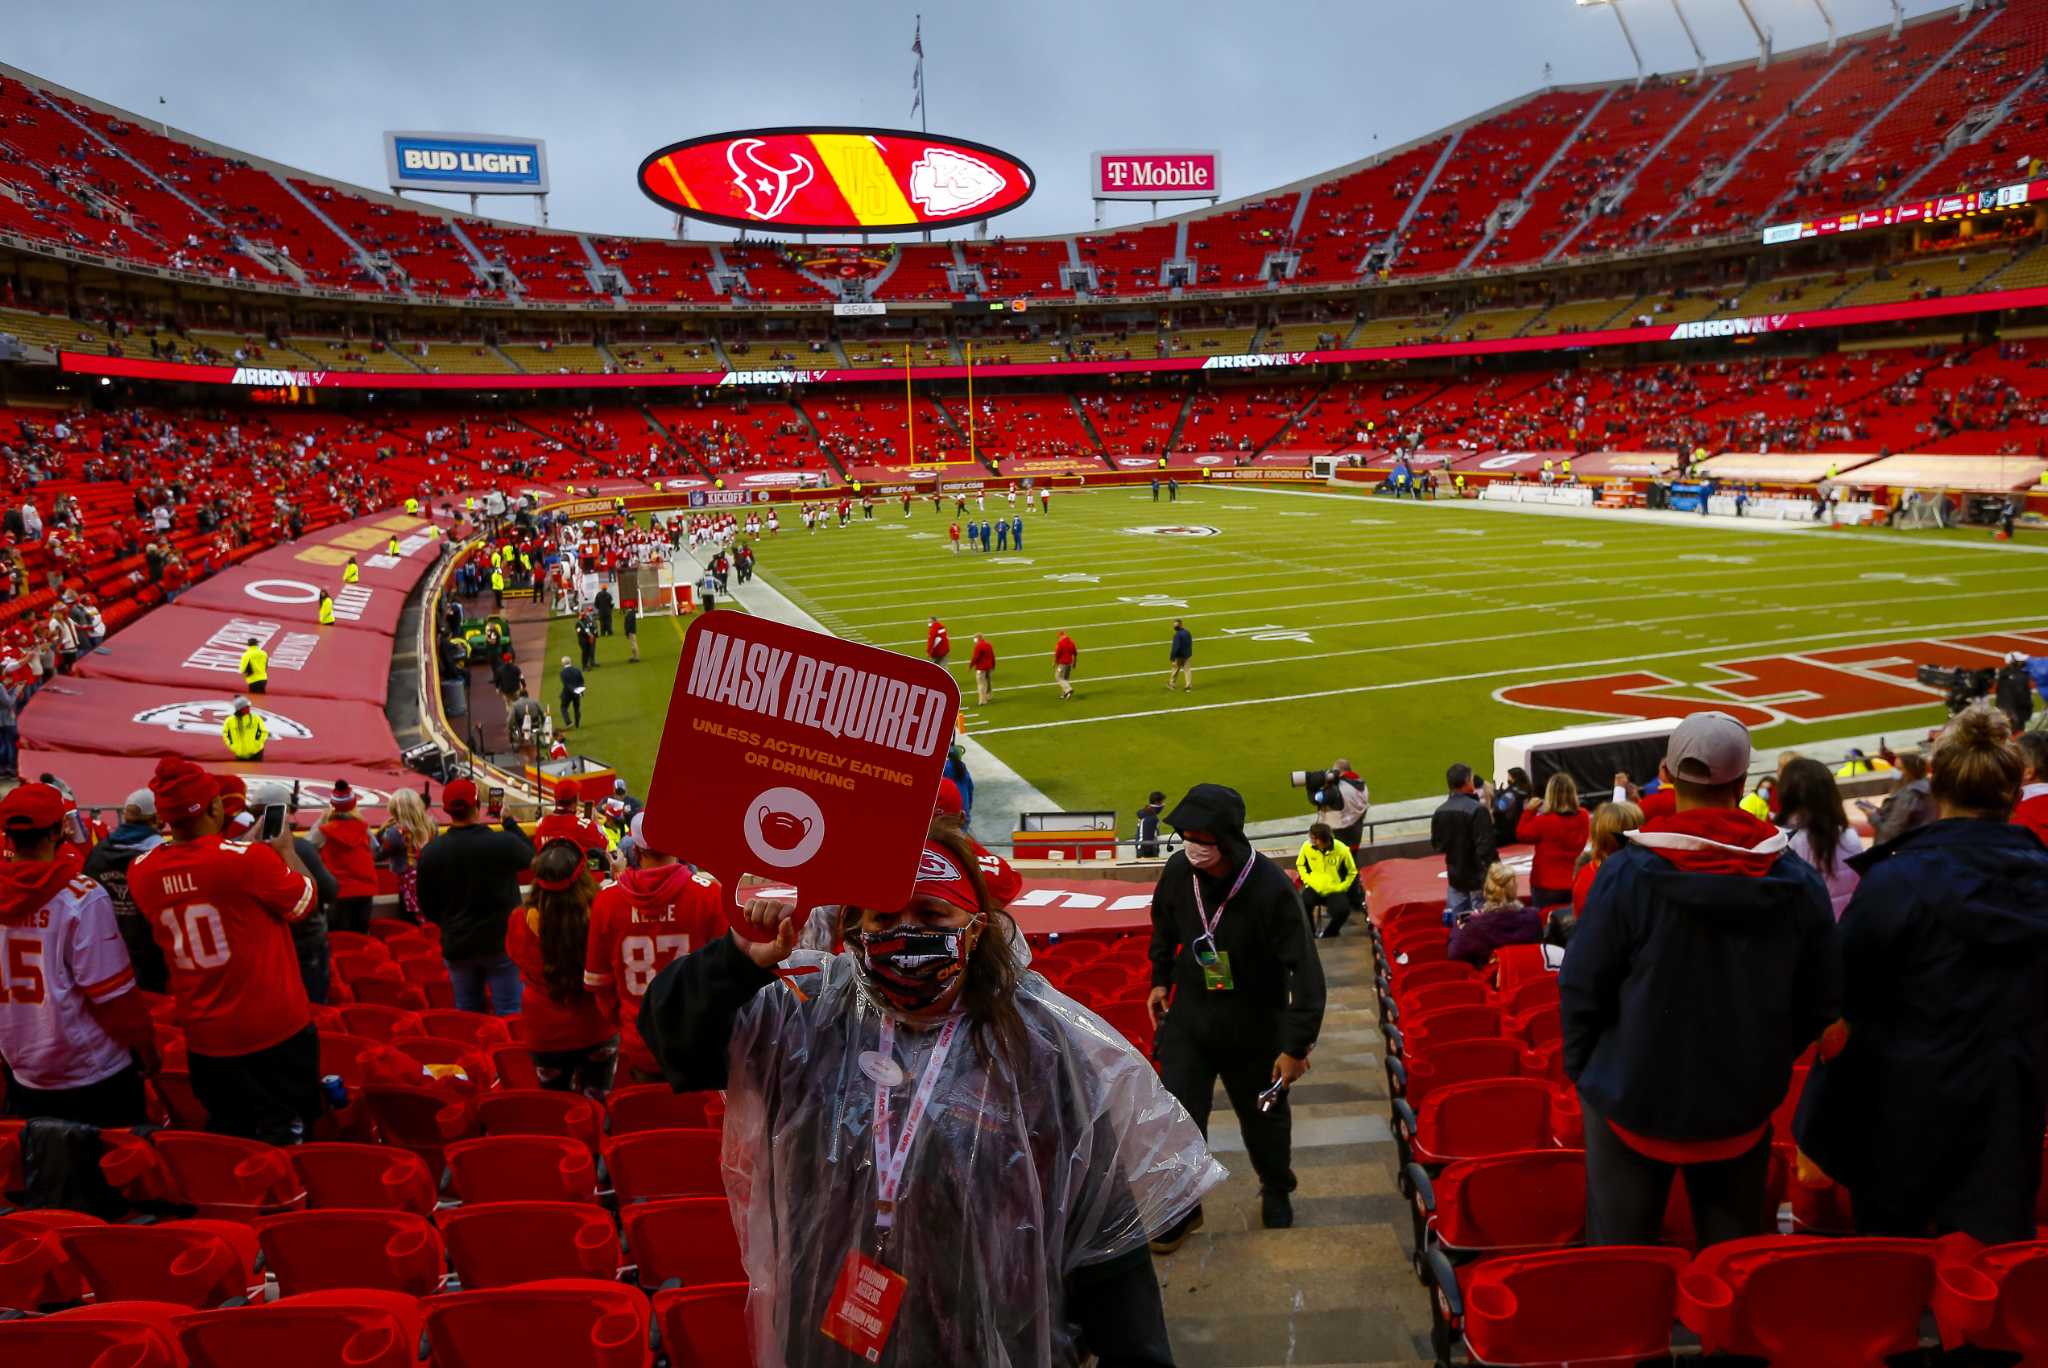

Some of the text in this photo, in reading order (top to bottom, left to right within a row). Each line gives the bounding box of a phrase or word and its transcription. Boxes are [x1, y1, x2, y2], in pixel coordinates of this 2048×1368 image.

[404, 149, 532, 174] BUD LIGHT
[1131, 160, 1208, 186] Mobile
[842, 304, 876, 316] GEHA
[707, 491, 744, 504] KICKOFF
[687, 630, 948, 757] MASK REQUIRED
[693, 717, 914, 788] UNLESS ACTIVELY EATING
[744, 751, 856, 792] OR DRINKING
[162, 872, 199, 895] HILL
[161, 902, 231, 970] 10
[622, 933, 691, 996] 87
